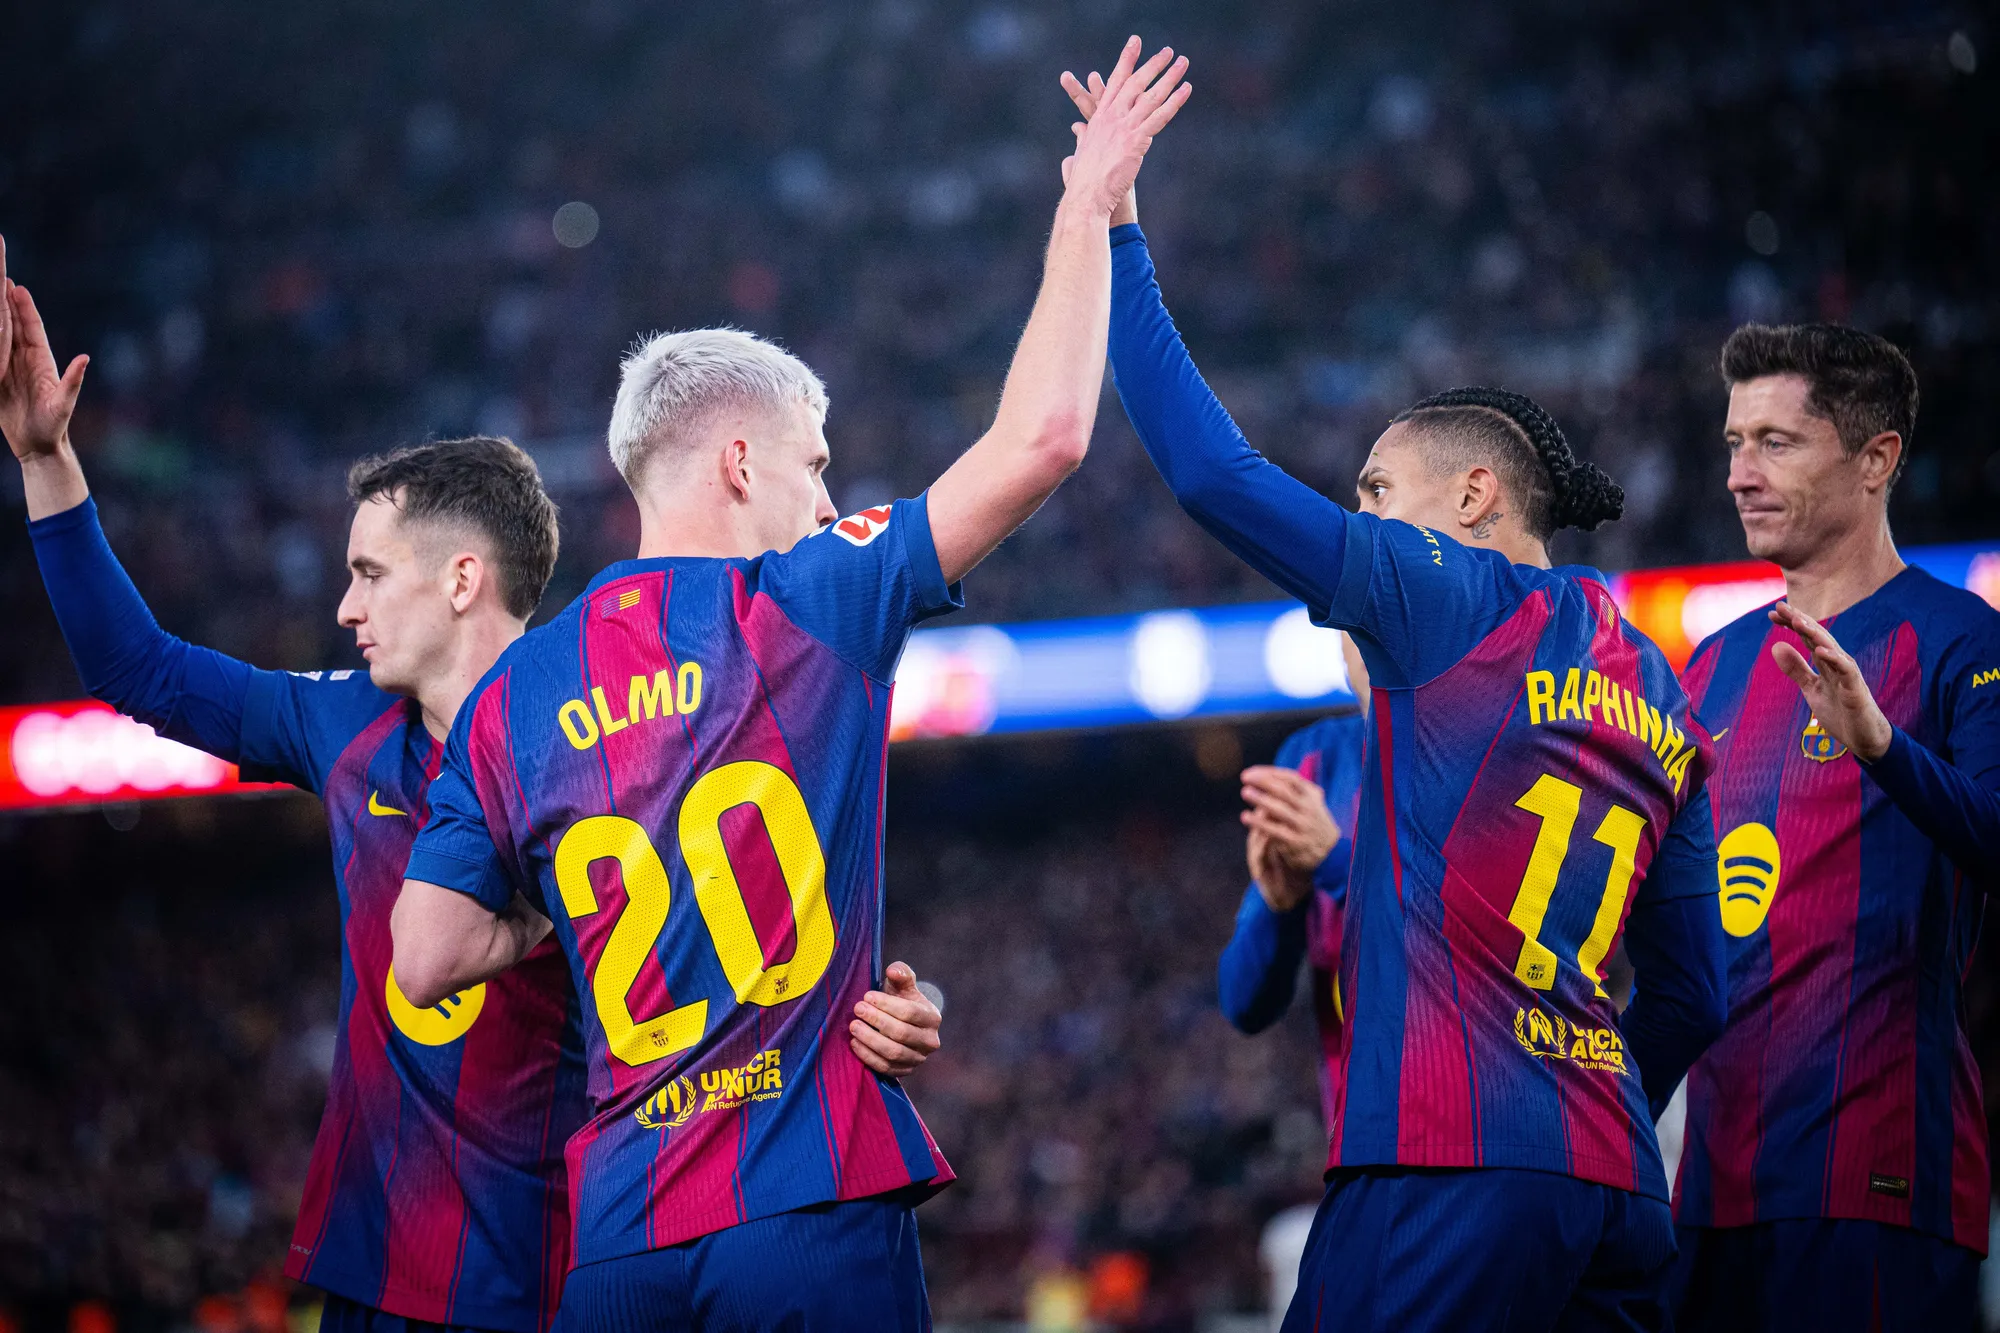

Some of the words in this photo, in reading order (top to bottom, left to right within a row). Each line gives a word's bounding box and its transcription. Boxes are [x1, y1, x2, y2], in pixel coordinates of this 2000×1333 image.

[558, 661, 702, 750] OLMO
[1526, 667, 1696, 796] RAPHINHA
[554, 760, 836, 1067] 20
[1507, 773, 1648, 999] 11
[752, 1091, 782, 1102] Agency
[1585, 1061, 1597, 1069] UN
